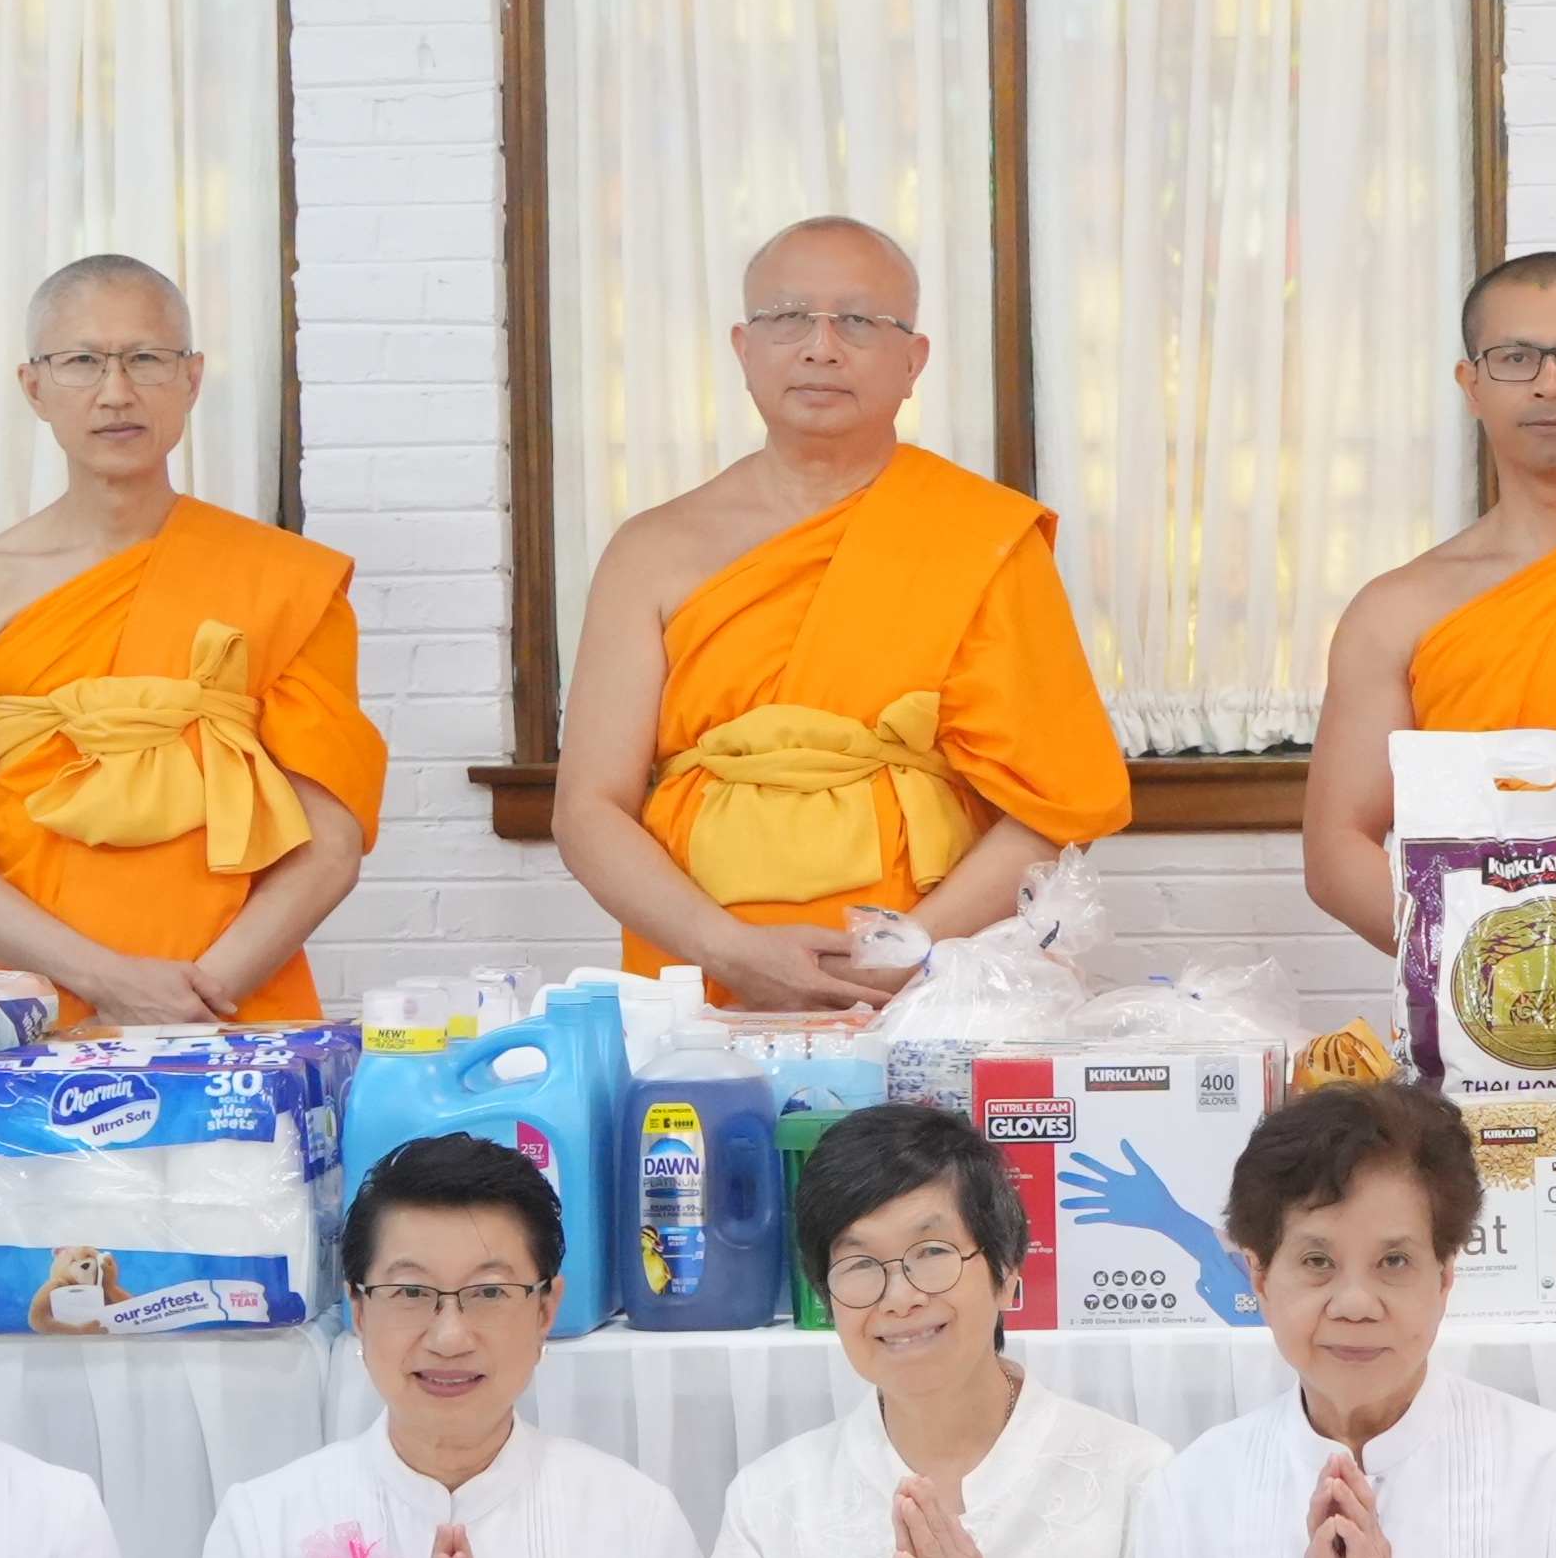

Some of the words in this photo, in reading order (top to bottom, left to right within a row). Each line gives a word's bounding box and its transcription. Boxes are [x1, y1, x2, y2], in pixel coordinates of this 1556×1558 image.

[377, 1029, 406, 1038] NEW!
[1088, 1068, 1167, 1082] KIRKLAND
[204, 1070, 264, 1098] 30
[1201, 1074, 1234, 1090] 400
[1462, 1080, 1509, 1093] THAI
[58, 1074, 134, 1117] Charmin
[1199, 1096, 1237, 1106] GLOVES
[991, 1103, 1033, 1114] NITRILE
[1036, 1103, 1069, 1113] EXAM
[91, 1115, 124, 1136] Ultra
[125, 1109, 152, 1124] Soft
[991, 1118, 1069, 1137] GLOVES
[1483, 1128, 1537, 1140] KIRKLAND
[520, 1144, 544, 1155] 257
[644, 1157, 699, 1175] DAWN
[643, 1177, 701, 1187] PLATINUM
[1462, 1215, 1508, 1256] at
[114, 1307, 140, 1323] our
[143, 1291, 204, 1316] softest,
[230, 1298, 258, 1307] TEAR
[141, 1313, 162, 1324] most
[1161, 1316, 1187, 1324] Gloves
